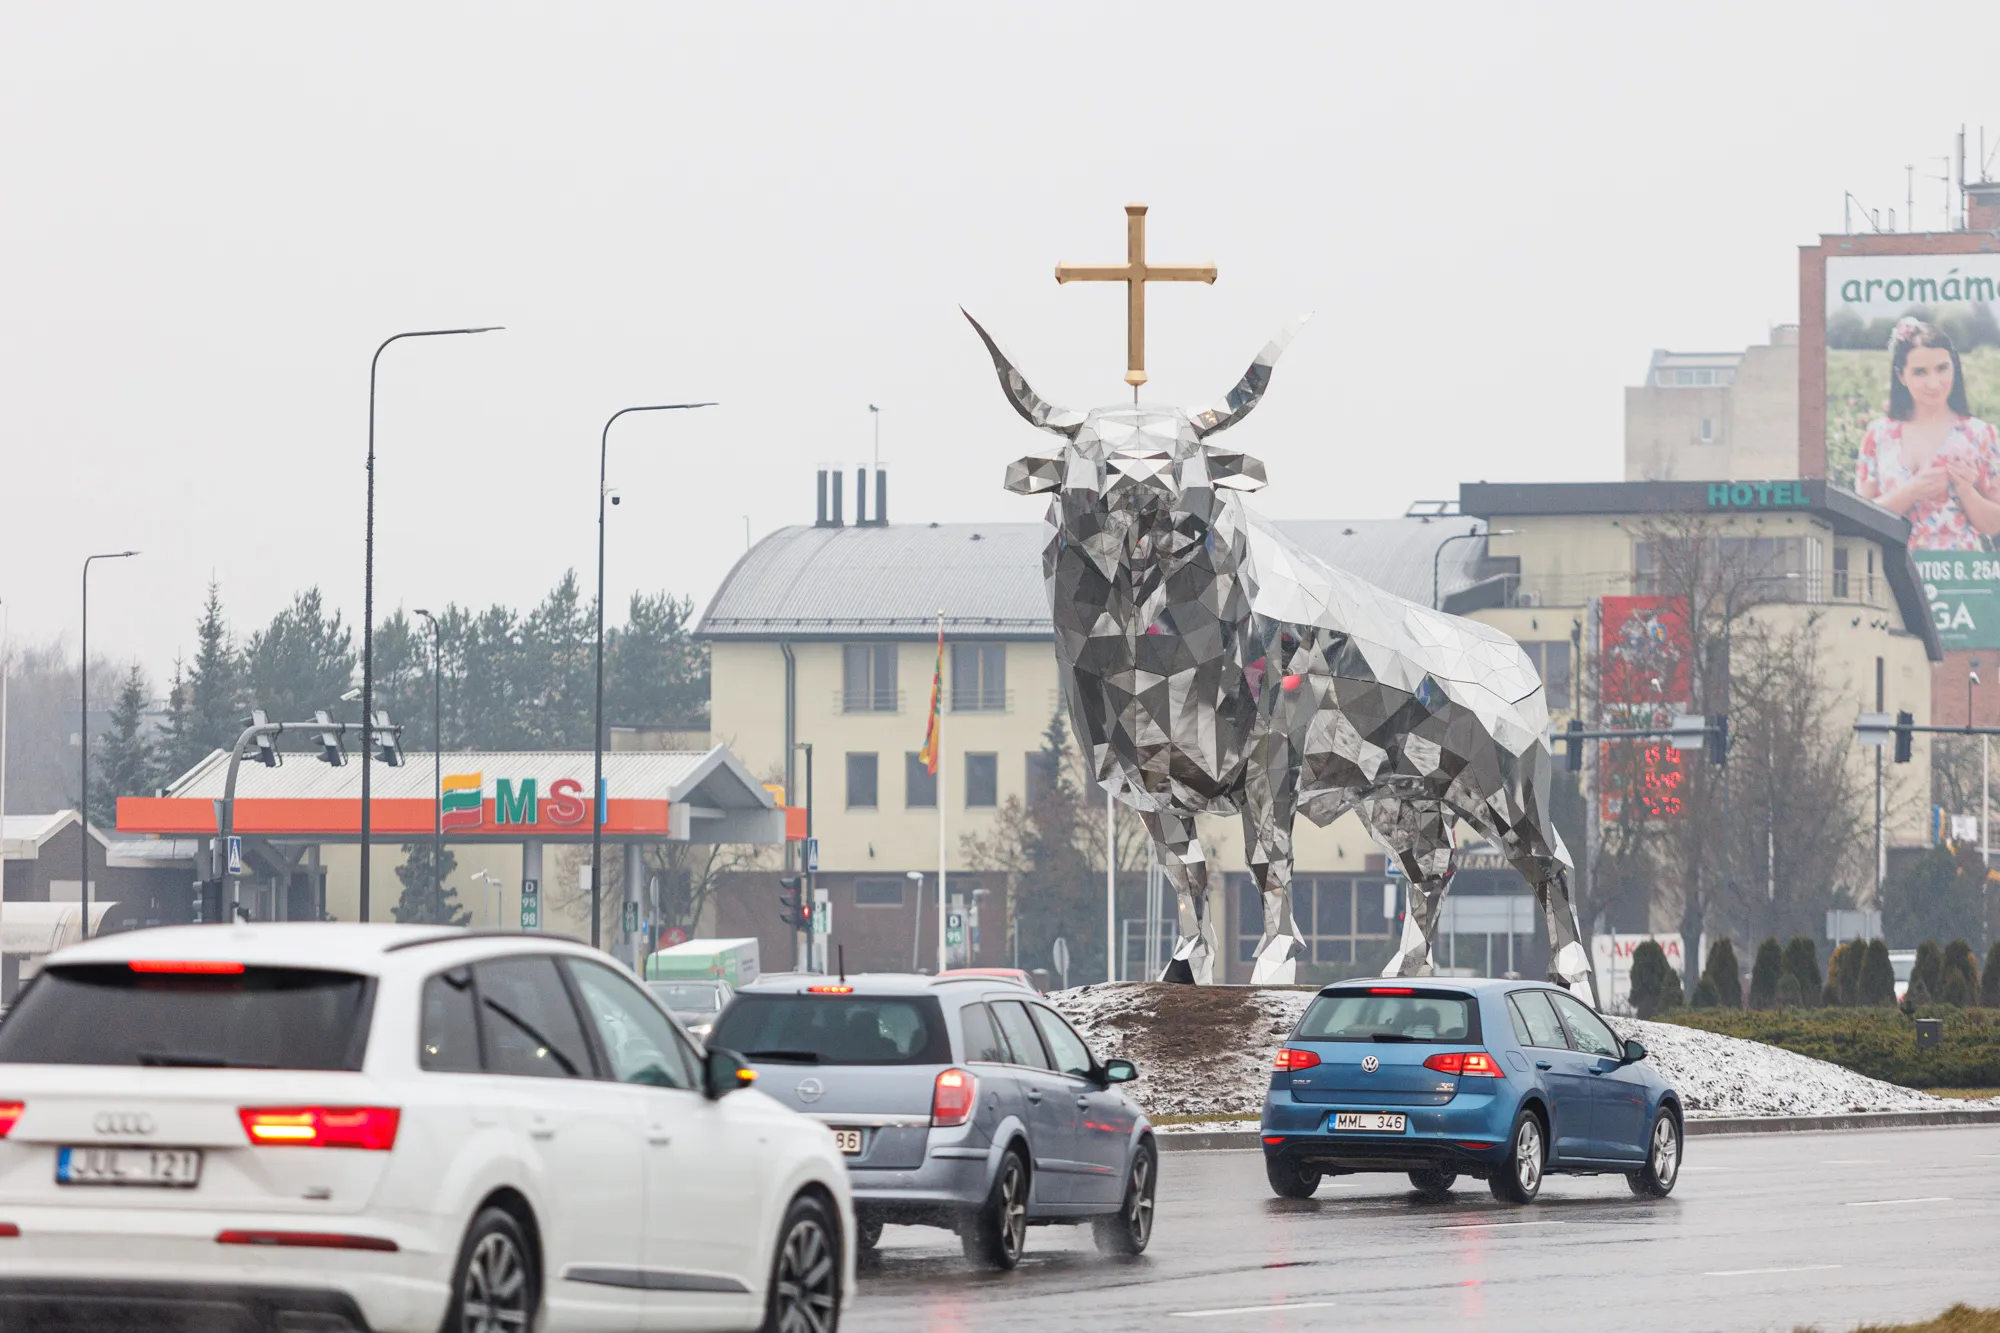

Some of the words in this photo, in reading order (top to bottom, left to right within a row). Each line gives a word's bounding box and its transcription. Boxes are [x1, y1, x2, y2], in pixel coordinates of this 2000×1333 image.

[1841, 267, 2000, 303] aromám
[1706, 482, 1811, 507] HOTEL
[525, 882, 534, 892] D
[522, 912, 536, 926] 98
[950, 915, 959, 927] D
[1337, 1114, 1367, 1129] MML
[1376, 1115, 1403, 1129] 346
[72, 1149, 124, 1176] JUL
[149, 1151, 191, 1177] 121
